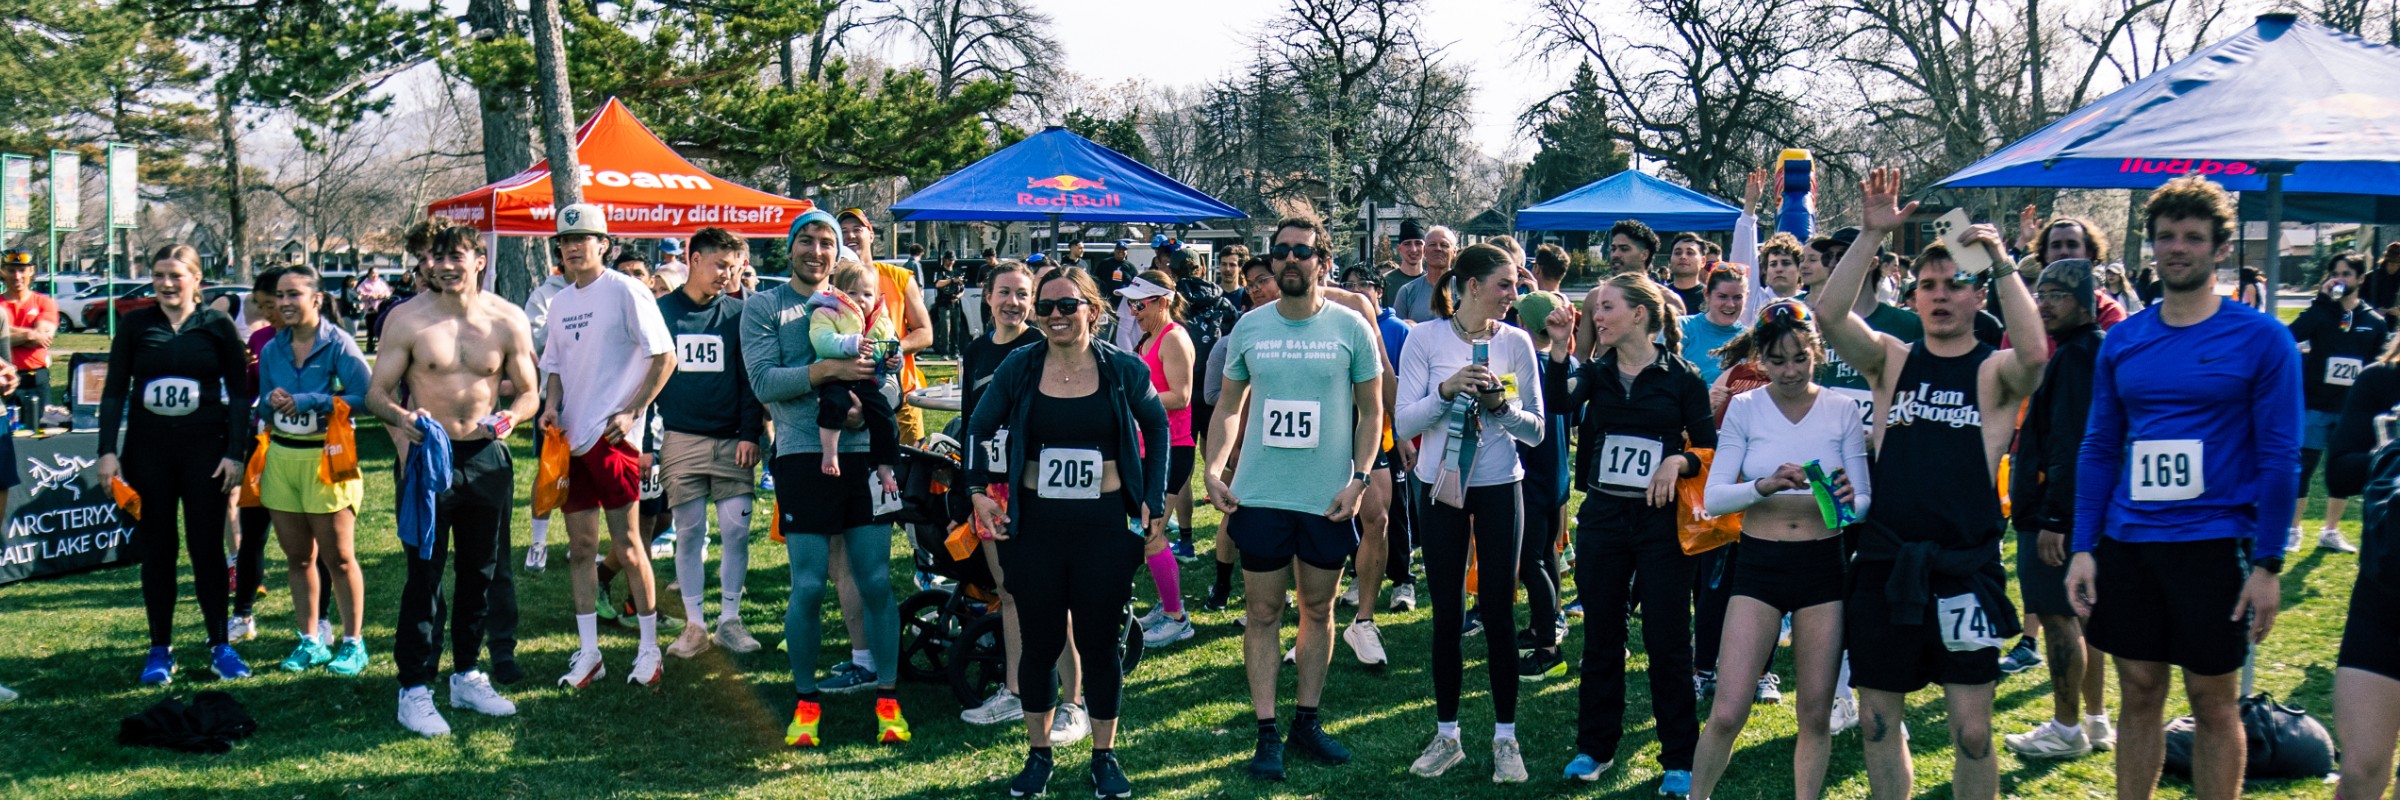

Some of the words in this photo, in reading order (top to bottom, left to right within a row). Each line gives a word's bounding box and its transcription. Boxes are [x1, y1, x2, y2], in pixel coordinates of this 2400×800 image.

[577, 164, 713, 191] foam
[1017, 192, 1066, 207] Red
[1071, 193, 1120, 207] Bull
[608, 204, 683, 226] laundry
[688, 205, 720, 222] did
[723, 205, 784, 223] itself?
[685, 342, 717, 363] 145
[1255, 340, 1282, 350] NEW
[1286, 340, 1340, 351] BALANCE
[153, 385, 191, 408] 184
[1917, 382, 1931, 402] I
[1930, 390, 1964, 406] am
[1886, 390, 1982, 429] Kenough
[1270, 410, 1312, 438] 215
[1048, 459, 1094, 488] 205
[1608, 446, 1652, 477] 179
[2141, 453, 2191, 487] 169
[8, 503, 117, 538] ARC'TERYX
[0, 542, 38, 567] ALT
[42, 533, 91, 559] LAKE
[95, 527, 134, 550] CITY
